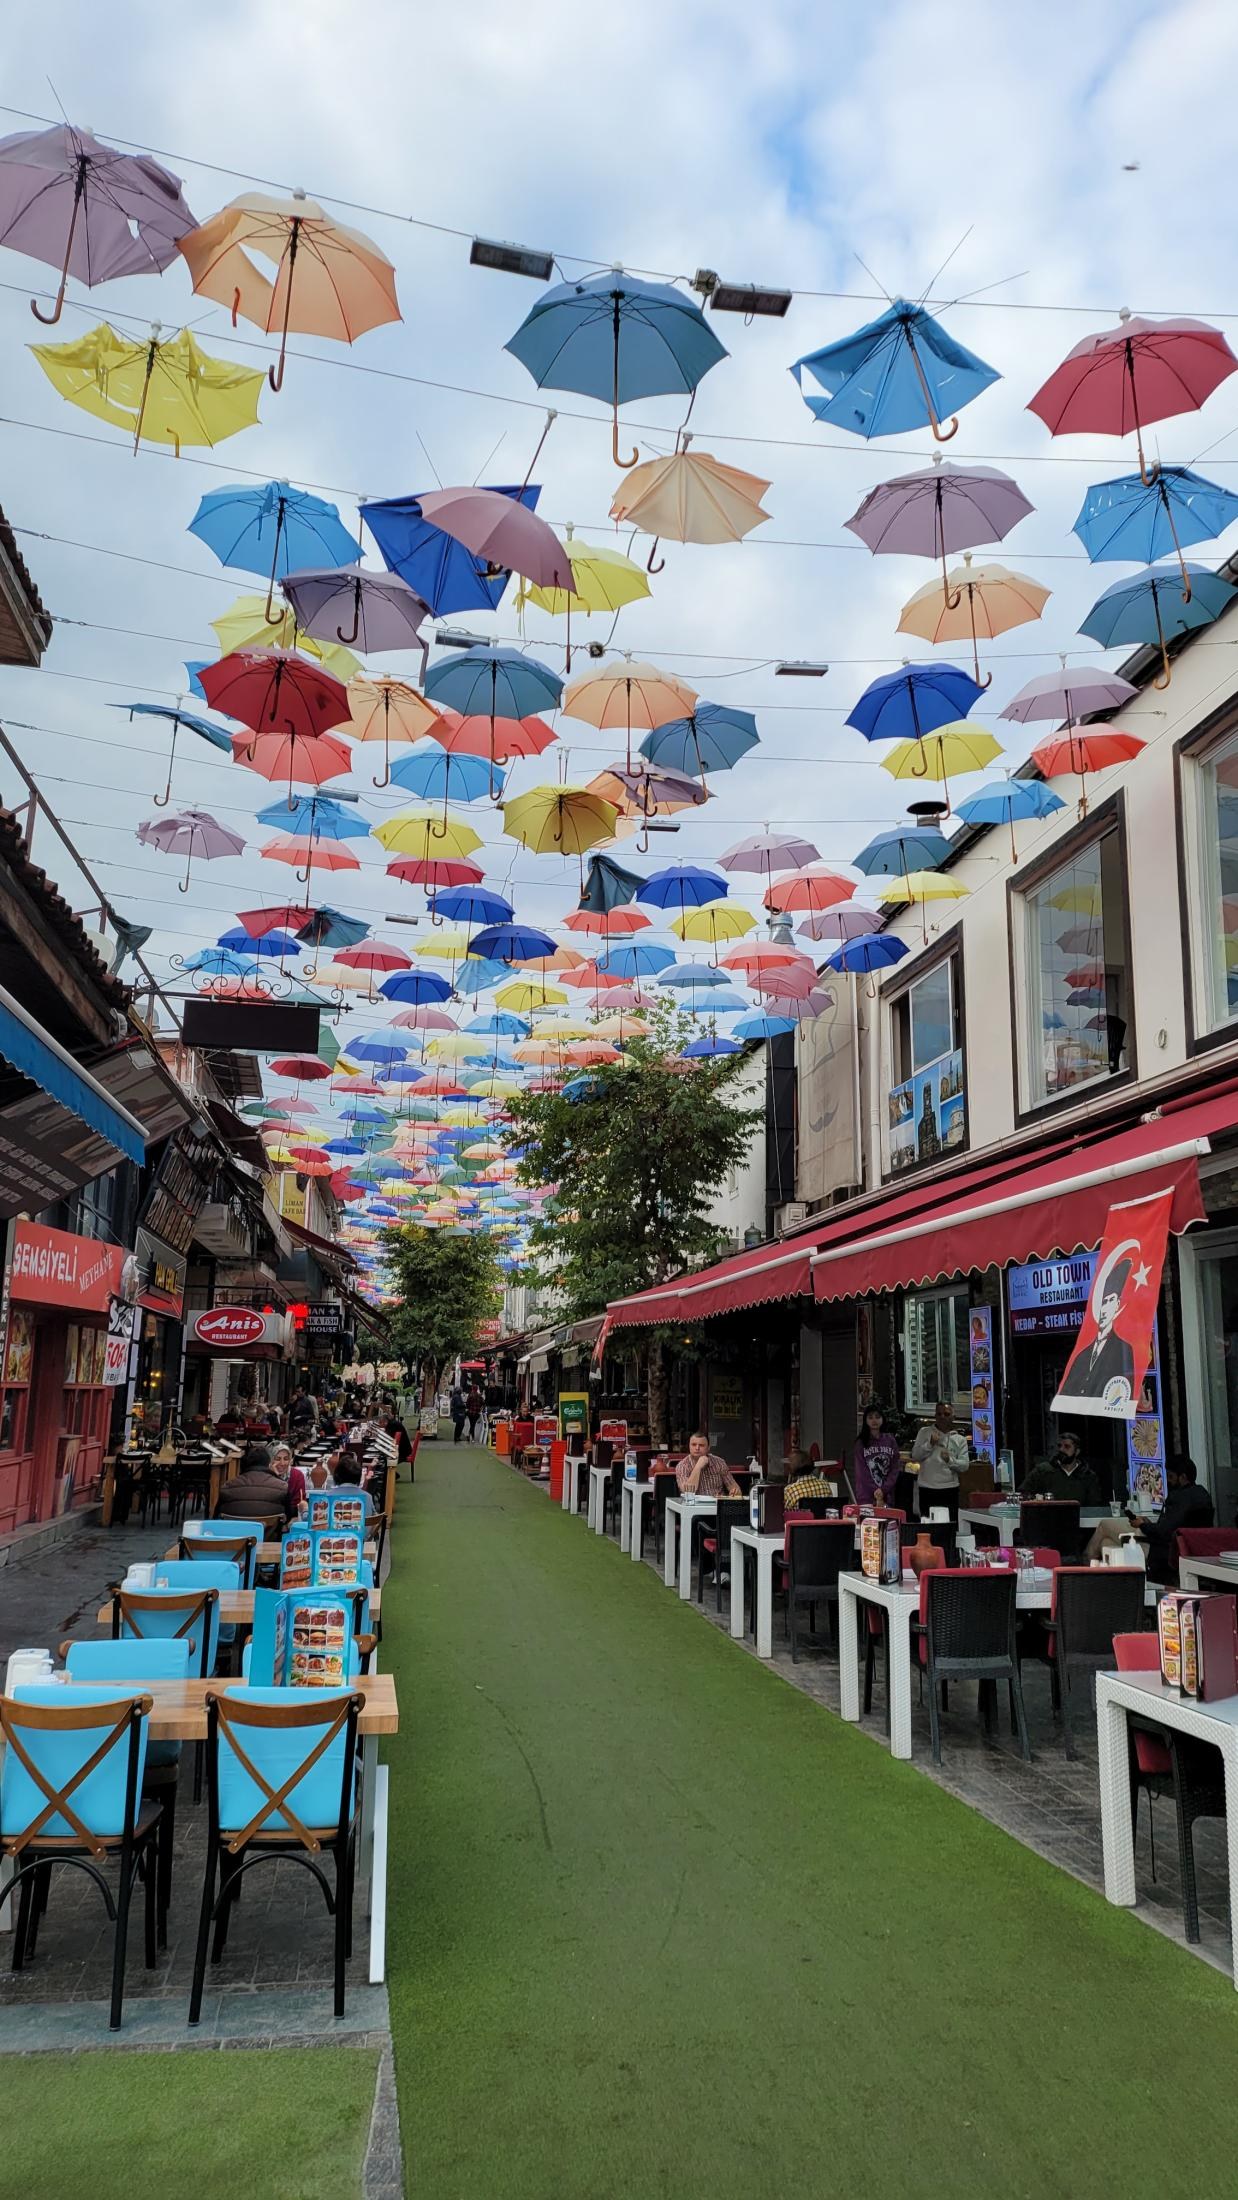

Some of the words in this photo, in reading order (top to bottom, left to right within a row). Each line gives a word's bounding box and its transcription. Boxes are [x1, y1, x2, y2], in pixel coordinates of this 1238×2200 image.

[1032, 1268, 1053, 1290] OLD
[1056, 1261, 1090, 1285] TOWN
[1, 1264, 11, 1322] ERKEK
[1040, 1286, 1084, 1304] RESTAURANT
[200, 1315, 260, 1331] Anis
[1014, 1317, 1037, 1331] KEBAP
[1044, 1313, 1069, 1329] STEAK
